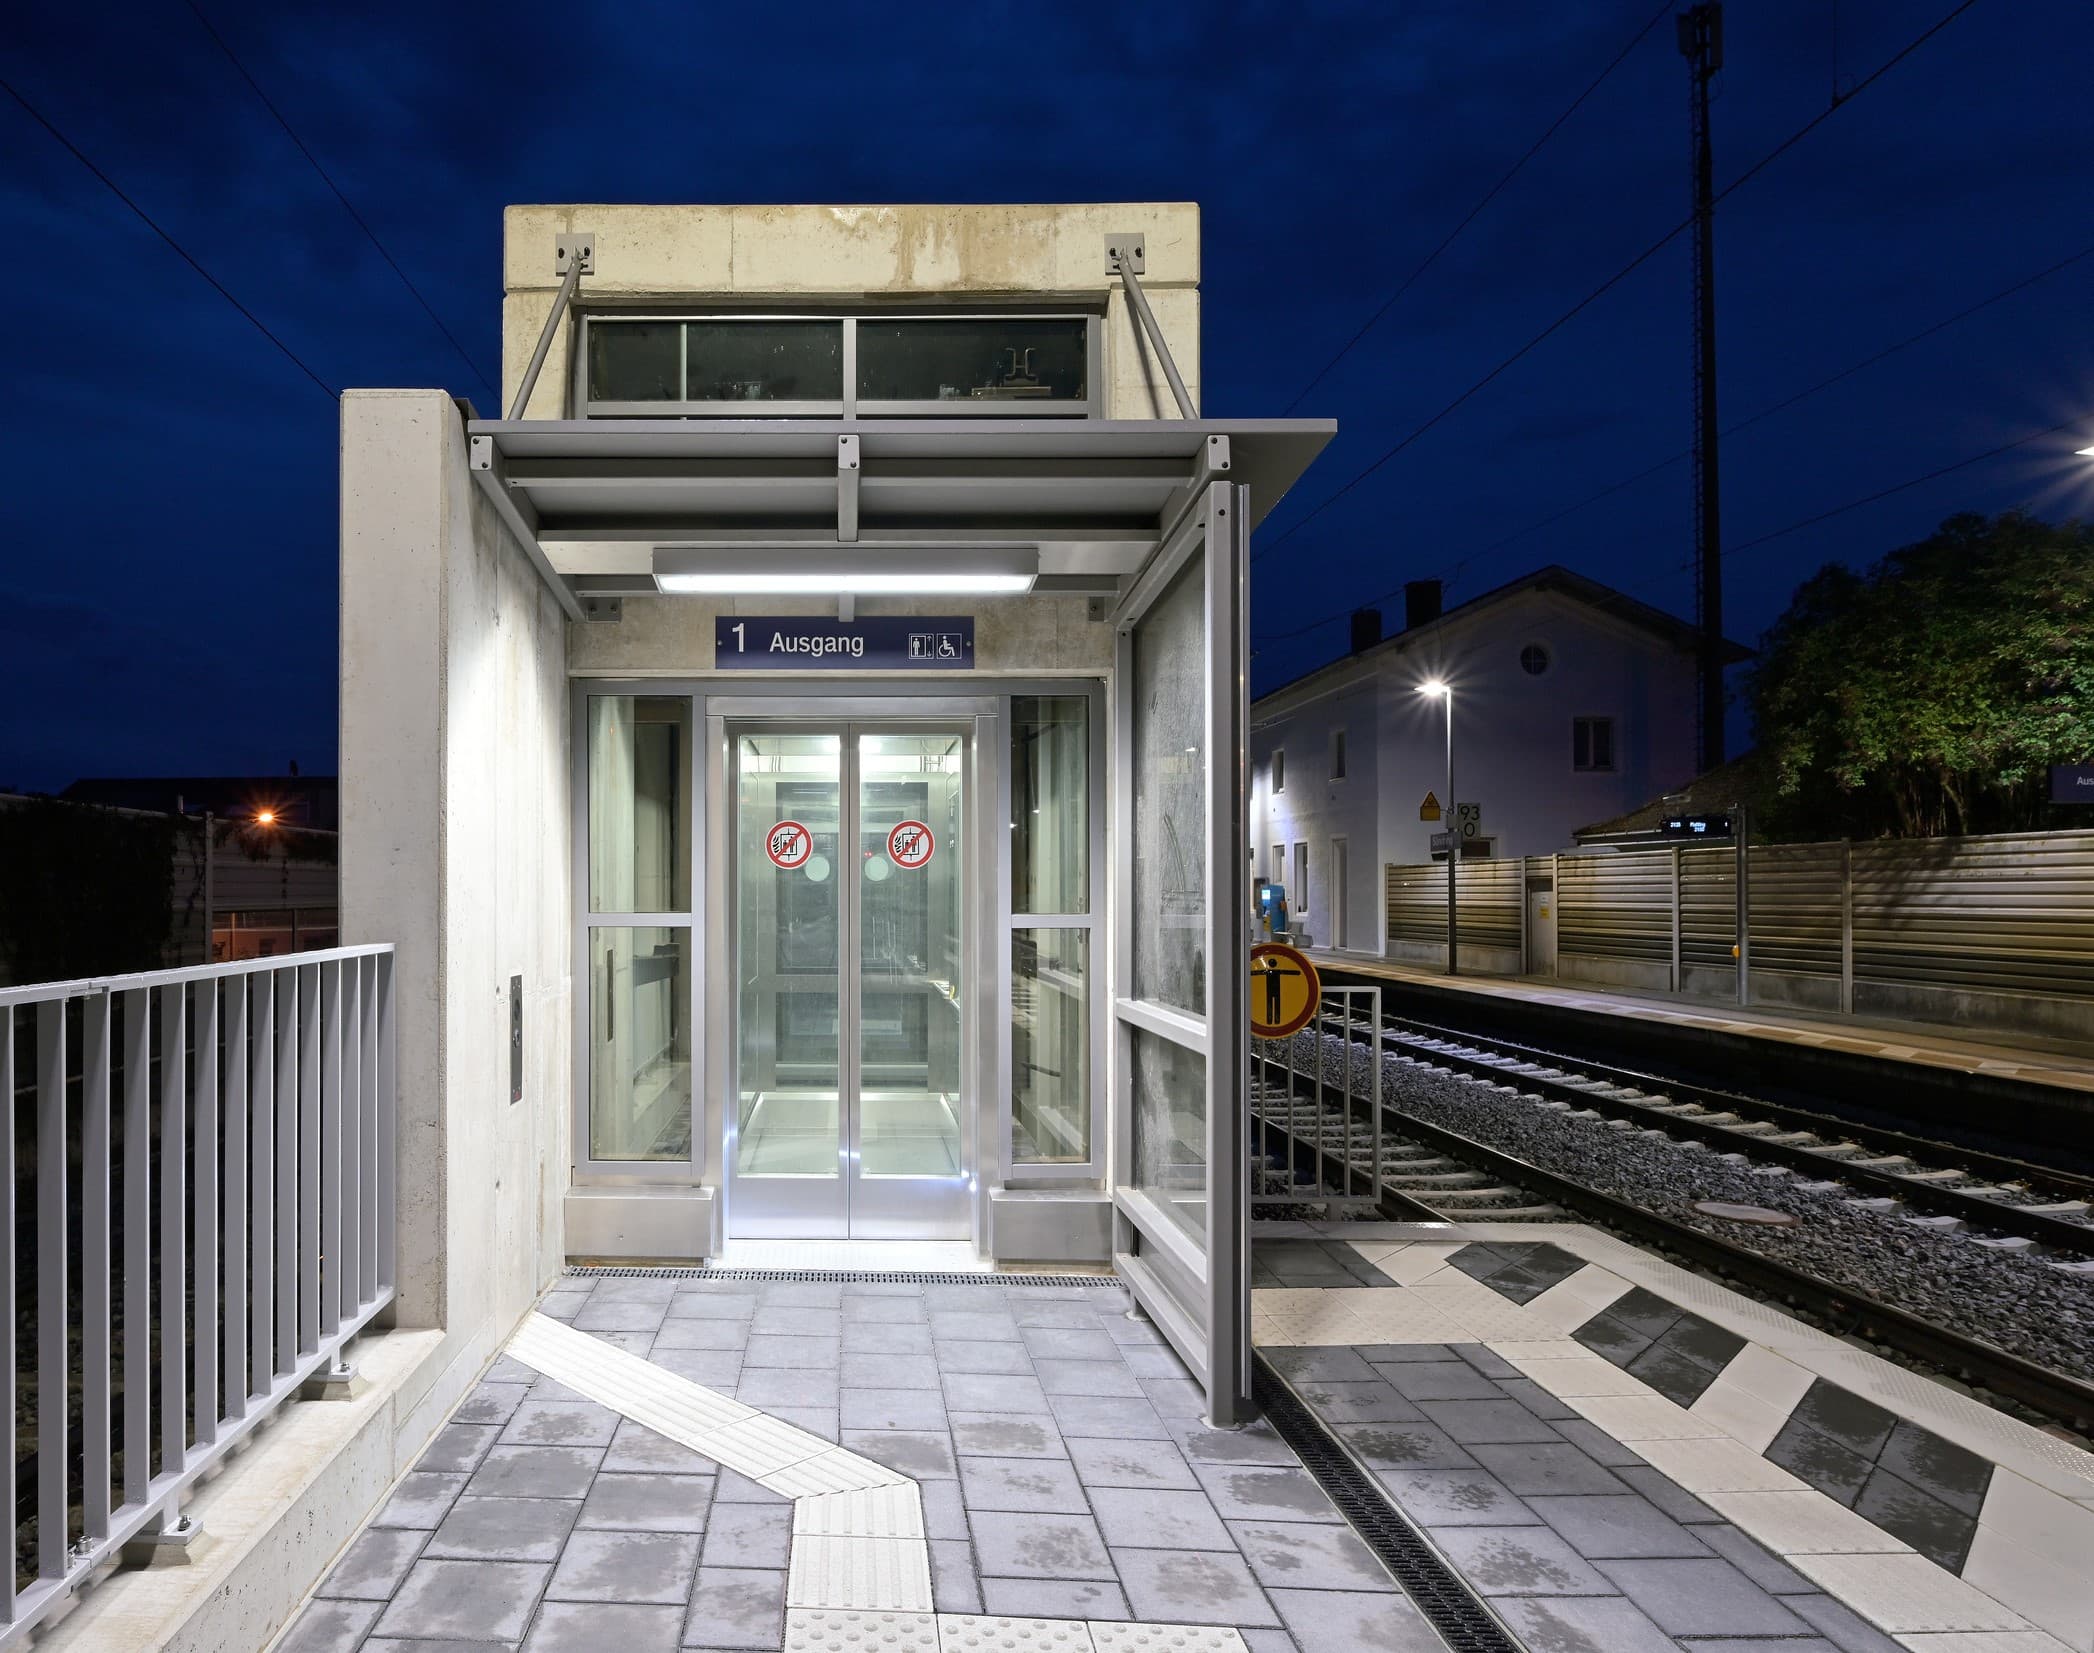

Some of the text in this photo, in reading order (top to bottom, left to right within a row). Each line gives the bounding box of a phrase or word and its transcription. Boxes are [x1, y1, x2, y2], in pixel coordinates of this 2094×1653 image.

[732, 622, 865, 657] 1 Ausgang
[1460, 805, 1480, 821] 93
[1464, 822, 1475, 837] 0
